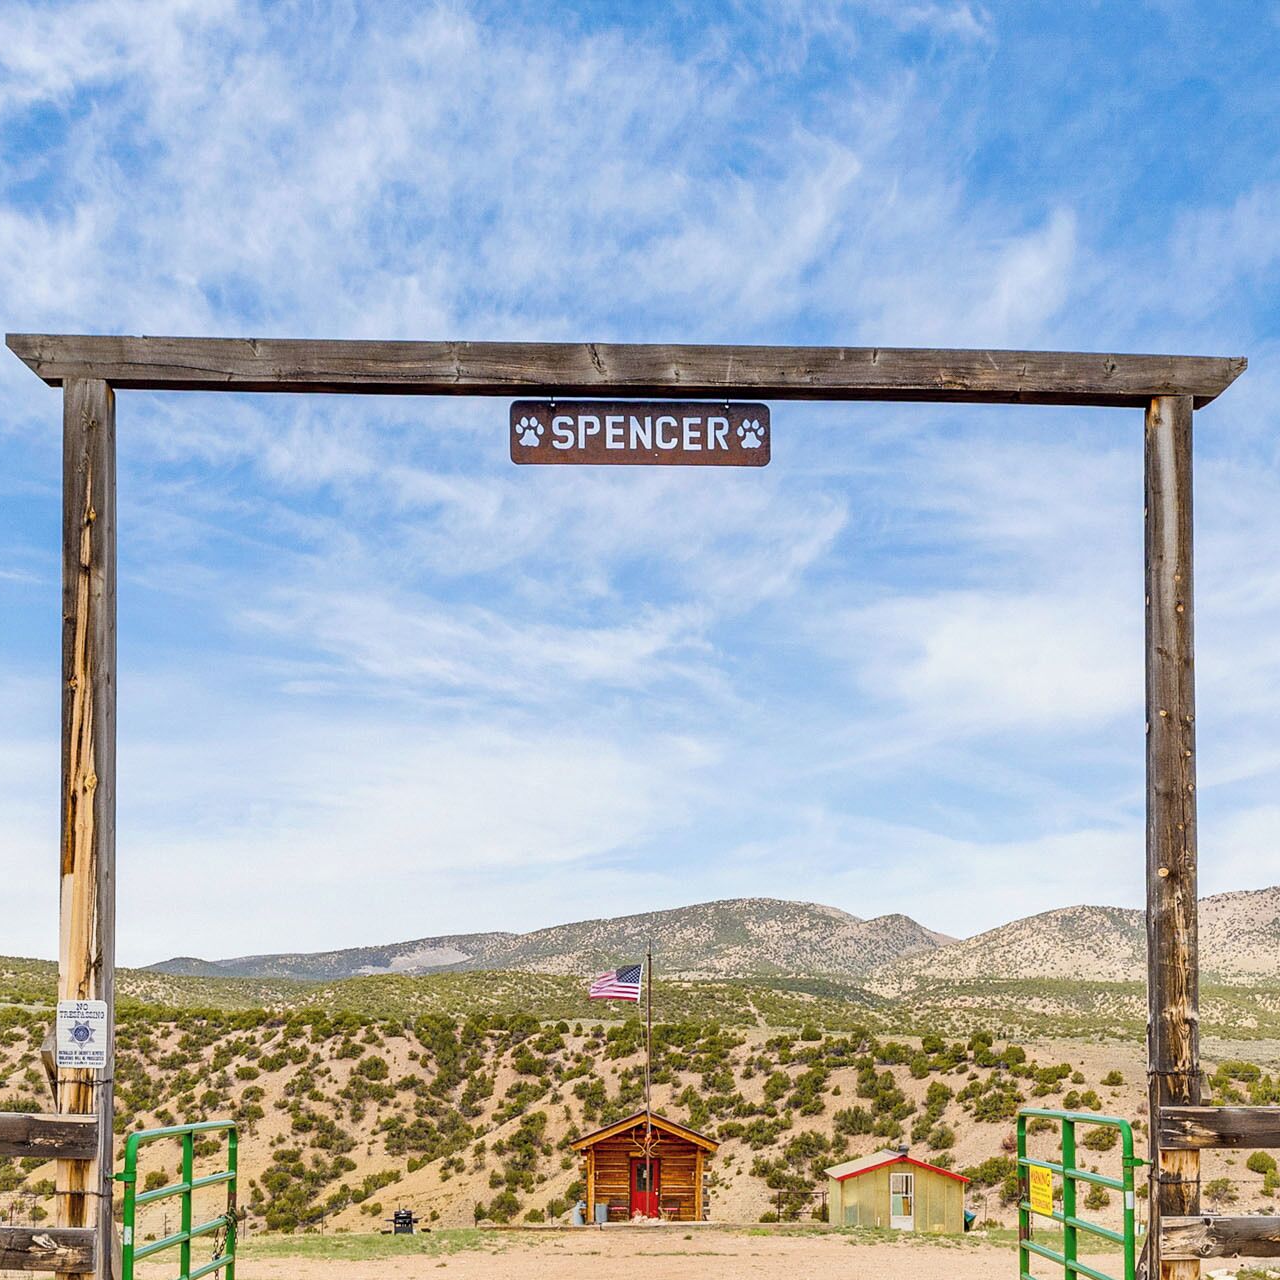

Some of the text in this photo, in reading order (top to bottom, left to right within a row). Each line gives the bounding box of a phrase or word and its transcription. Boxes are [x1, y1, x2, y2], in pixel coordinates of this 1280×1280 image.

[551, 415, 729, 450] SPENCER
[76, 1003, 89, 1011] NO
[59, 1010, 105, 1019] TRESPASSING
